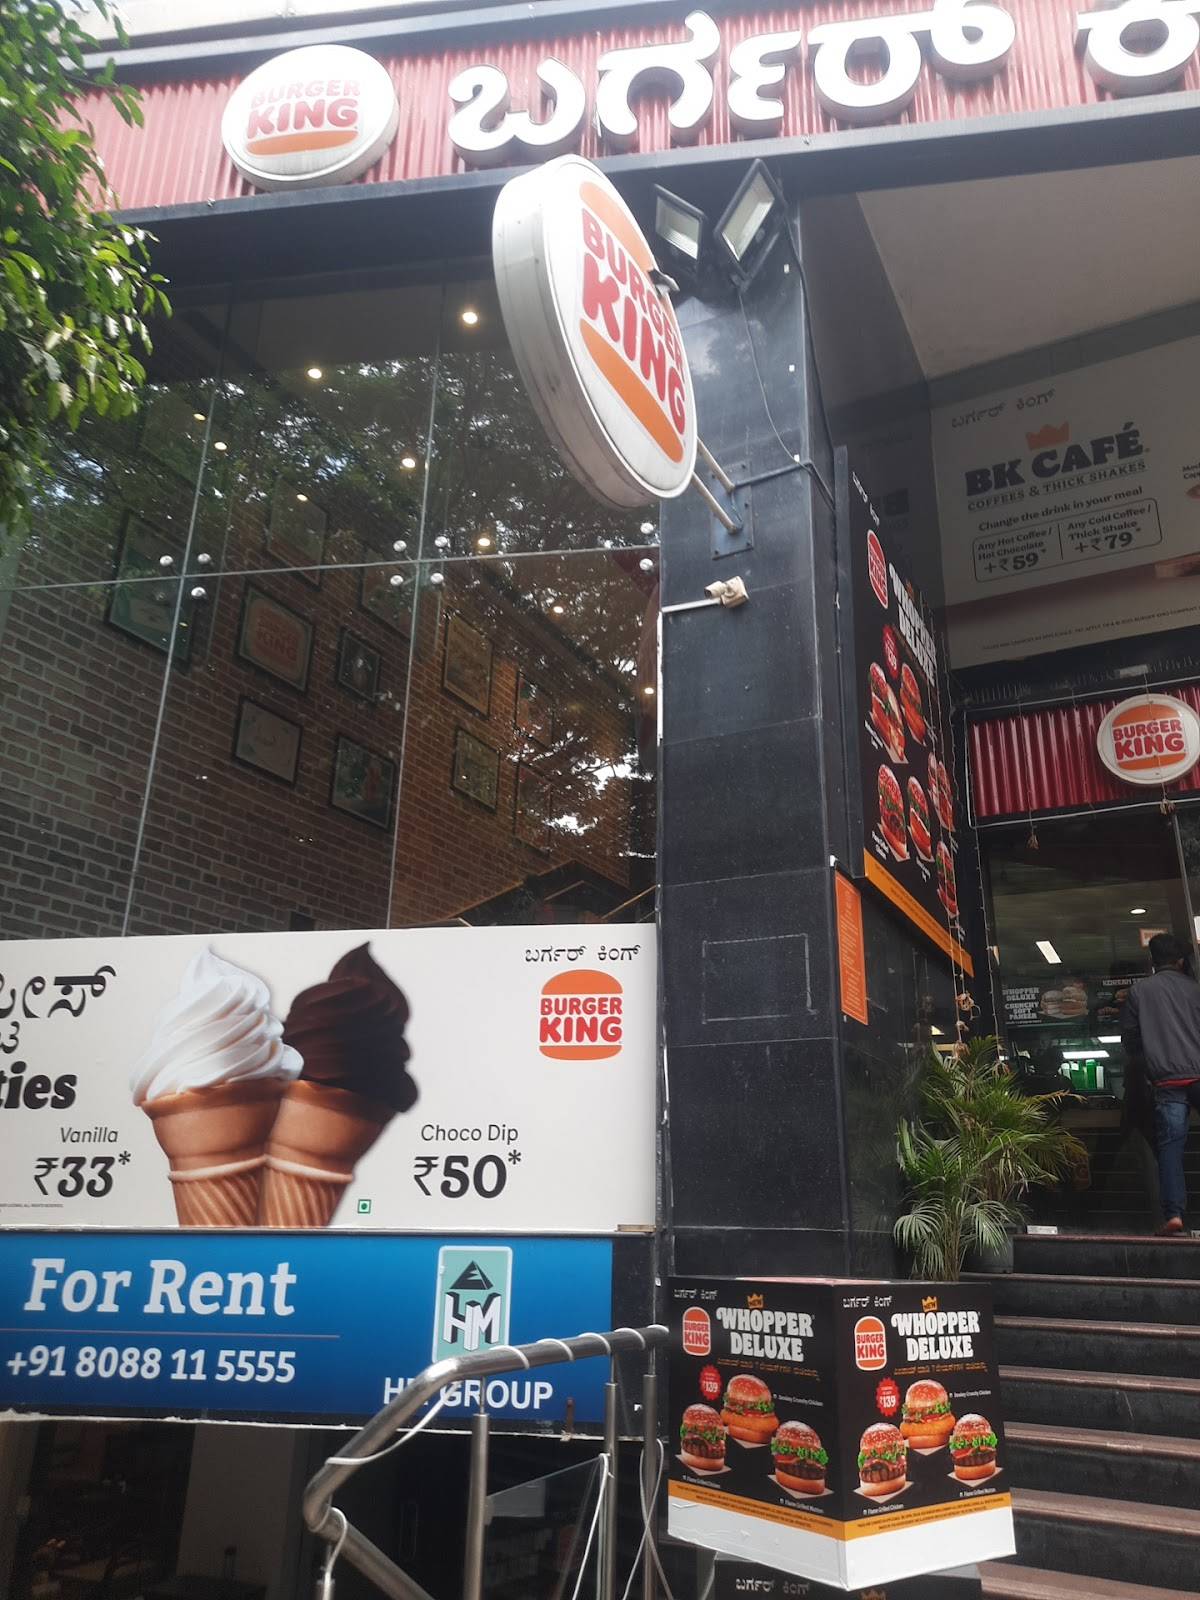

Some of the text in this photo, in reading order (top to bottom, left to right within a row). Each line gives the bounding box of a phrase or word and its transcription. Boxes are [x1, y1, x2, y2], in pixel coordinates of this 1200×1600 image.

[250, 77, 361, 110] BURGER
[246, 98, 360, 140] KING
[582, 207, 684, 378] BURGER
[582, 252, 686, 436] KING
[965, 421, 1144, 496] BK CAFÉ
[968, 461, 1146, 511] COFFEES & THICK SHAKES
[978, 485, 1144, 533] Change the drink in your meal
[1067, 520, 1089, 533] Any
[1089, 513, 1112, 526] Cold
[1112, 507, 1145, 520] Coffee
[978, 541, 996, 551] Any
[997, 536, 1015, 547] Hot
[1016, 530, 1048, 542] Coffee
[1068, 519, 1138, 542] Thick Shake
[978, 540, 1045, 561] Hot Chocolate
[1113, 719, 1182, 742] BURGER
[1114, 733, 1185, 760] KING
[525, 944, 642, 962] ಬರ್ಗರ್ ಕಿಂಗ್
[540, 997, 623, 1016] BURGER
[539, 1016, 622, 1043] KING
[60, 1126, 119, 1143] Vanilla
[421, 1123, 520, 1146] Choco Dip
[23, 1257, 297, 1317] For Rent
[442, 1291, 502, 1352] HM
[684, 1321, 709, 1333] BURGER
[716, 1306, 814, 1338] WHOPPER
[891, 1310, 981, 1337] WHOPPER
[684, 1332, 710, 1346] KING
[730, 1331, 805, 1362] DELUXE
[856, 1333, 885, 1345] BURGER
[857, 1344, 885, 1359] KING
[906, 1335, 974, 1362] DELUXE
[6, 1344, 297, 1384] +91 8088 11 5555
[440, 1378, 554, 1410] GROUP
